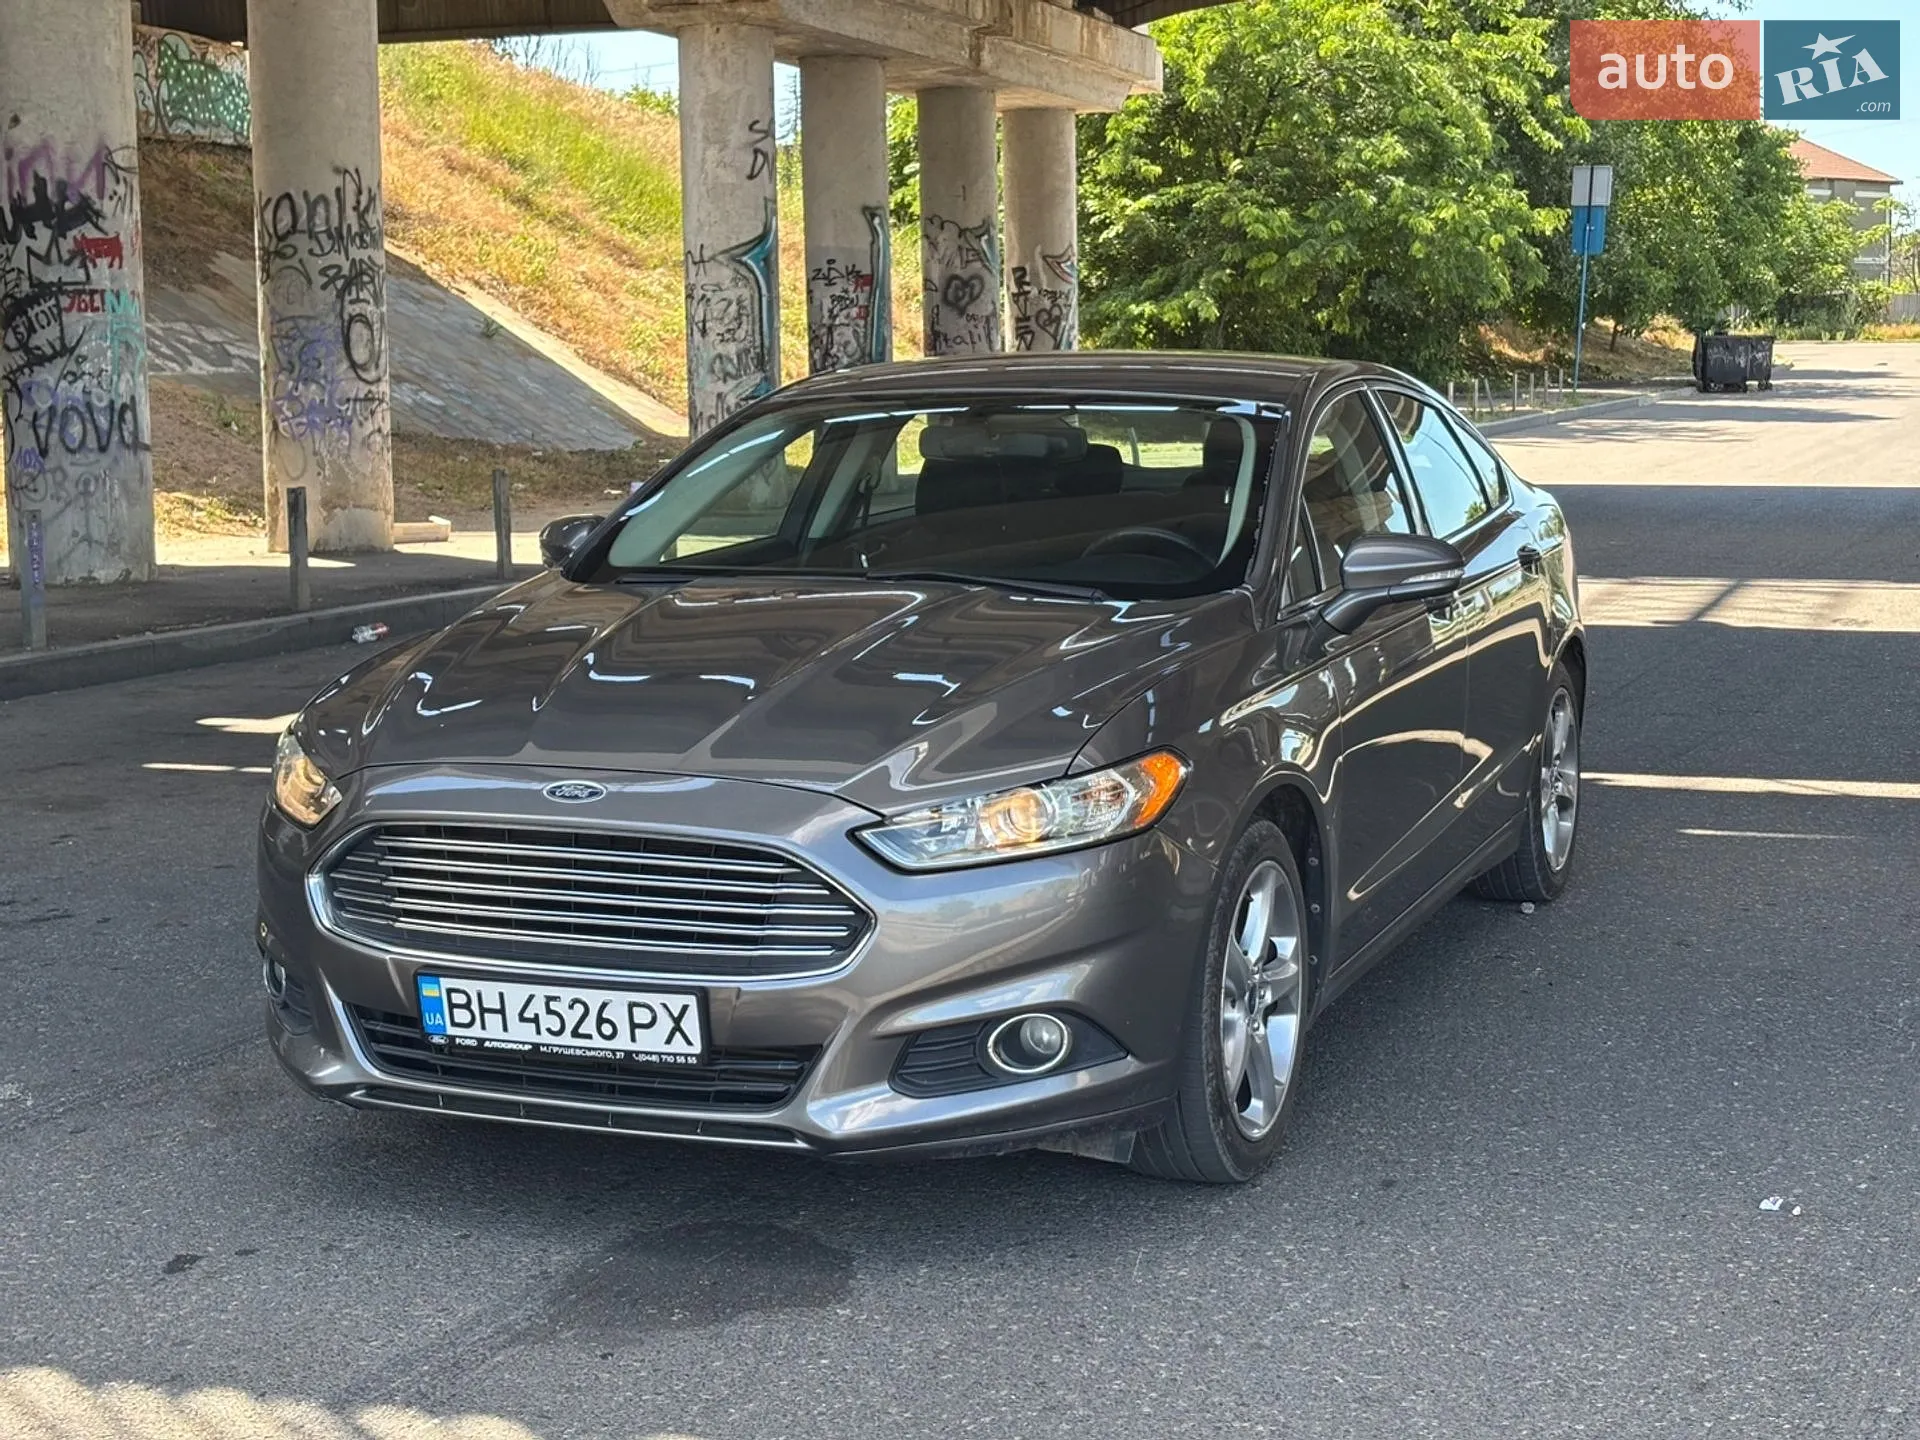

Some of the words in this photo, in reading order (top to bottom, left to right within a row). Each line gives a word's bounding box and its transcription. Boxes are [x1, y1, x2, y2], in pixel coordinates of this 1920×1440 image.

[424, 1011, 444, 1027] UA
[445, 987, 509, 1034] BH
[517, 993, 620, 1042] 4526
[627, 1000, 695, 1047] PX
[455, 1037, 478, 1047] FORD
